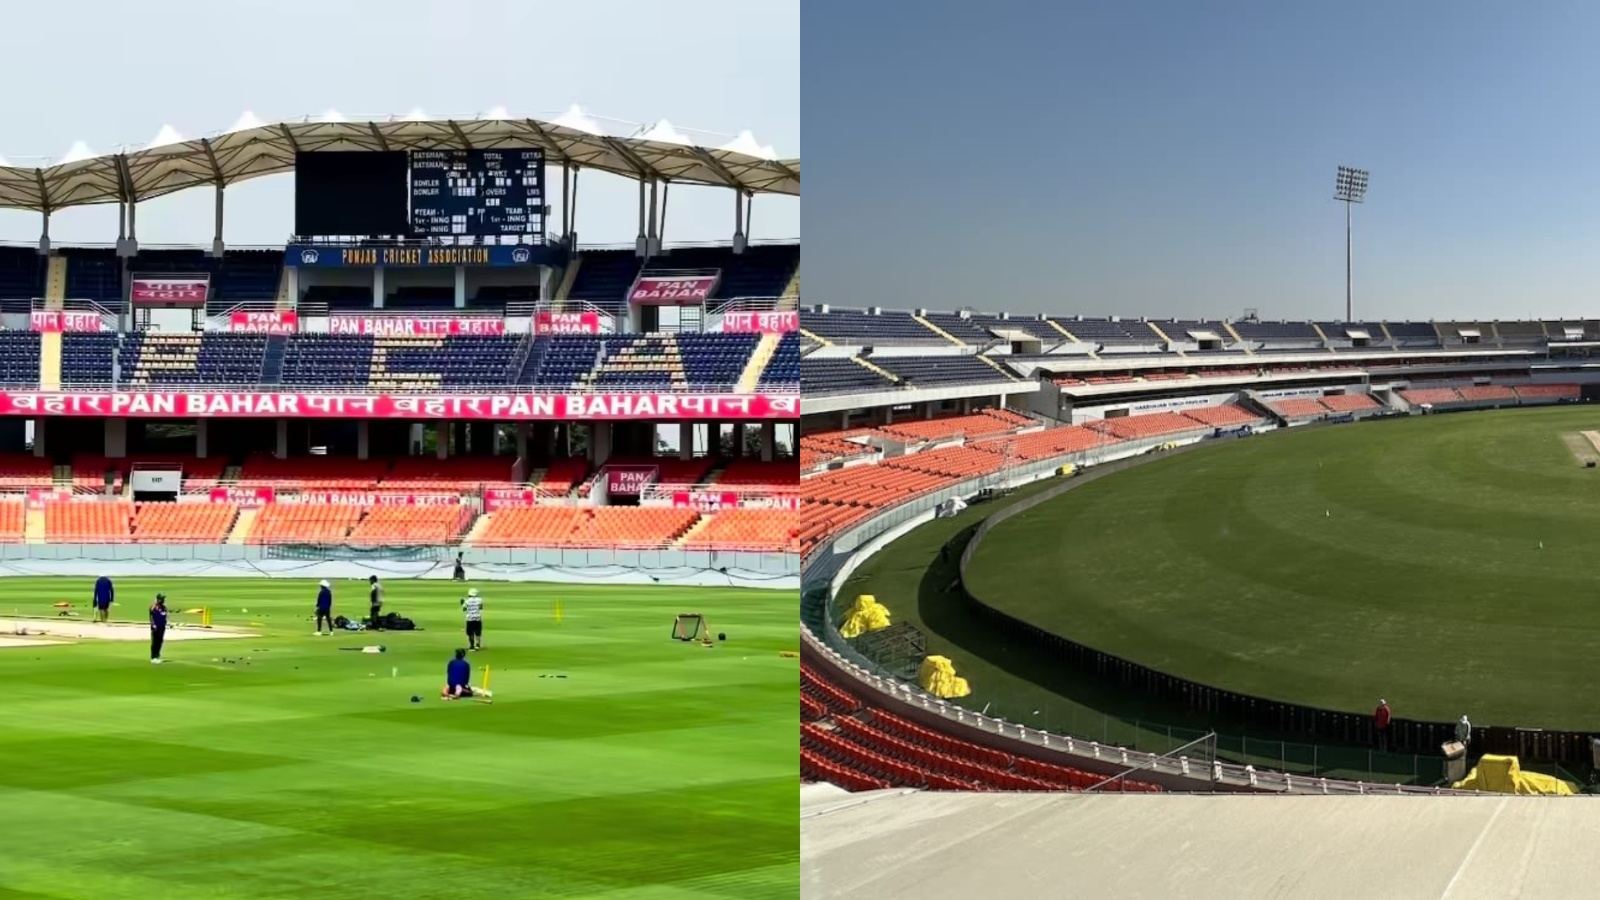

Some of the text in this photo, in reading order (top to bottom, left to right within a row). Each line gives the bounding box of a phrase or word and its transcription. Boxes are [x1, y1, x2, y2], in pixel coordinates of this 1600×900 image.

[483, 152, 503, 160] TOTAL
[342, 248, 488, 264] PUNJAB CRICKET ASSOCIATION
[656, 281, 698, 289] PAN
[632, 288, 706, 298] BAHAR
[248, 312, 280, 322] PAN
[551, 313, 580, 323] PAN
[331, 318, 359, 334] PAN
[364, 319, 413, 335] BAHAR
[112, 393, 172, 413] PAN
[187, 394, 299, 413] BAHAR
[303, 395, 374, 413] पान
[491, 396, 554, 415] PAN
[565, 396, 678, 415] BAHAR
[679, 394, 756, 413] पान
[620, 472, 644, 481] PAN
[227, 489, 256, 498] PAN
[690, 493, 720, 502] PAN
[302, 493, 326, 505] PAN
[331, 493, 375, 506] BAHAR
